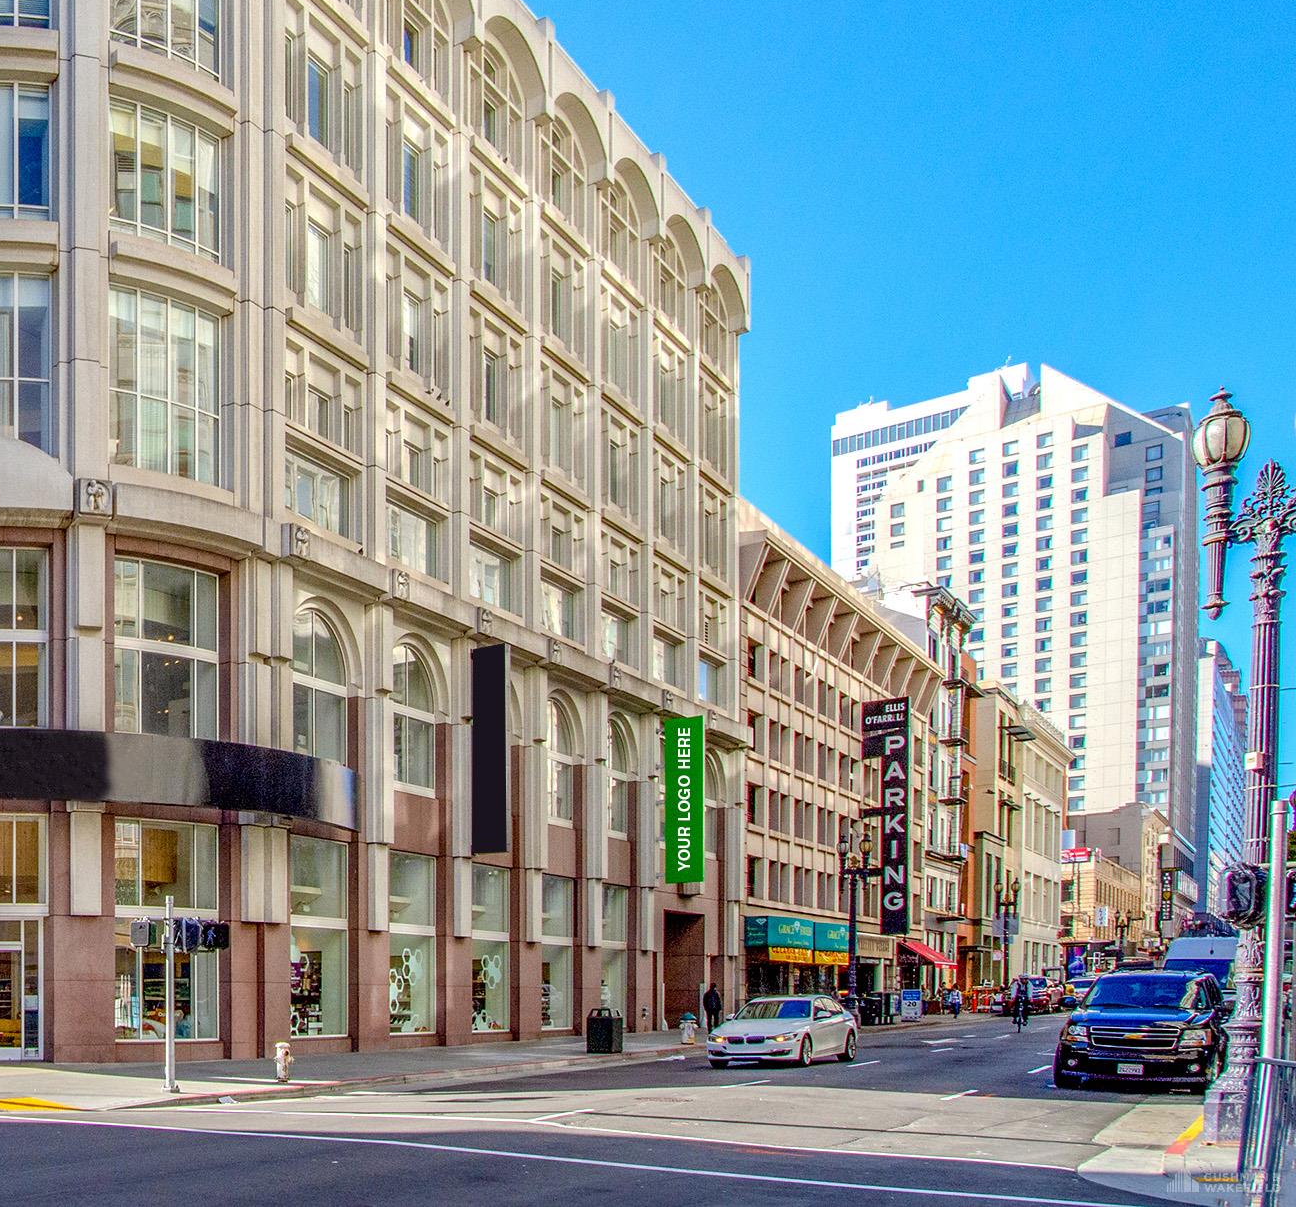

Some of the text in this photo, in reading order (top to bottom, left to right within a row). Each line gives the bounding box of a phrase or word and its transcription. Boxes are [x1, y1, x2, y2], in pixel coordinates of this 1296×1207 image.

[885, 702, 905, 712] ELLIS
[678, 728, 690, 871] YOUR LOGO HERE
[883, 735, 905, 910] PARKING
